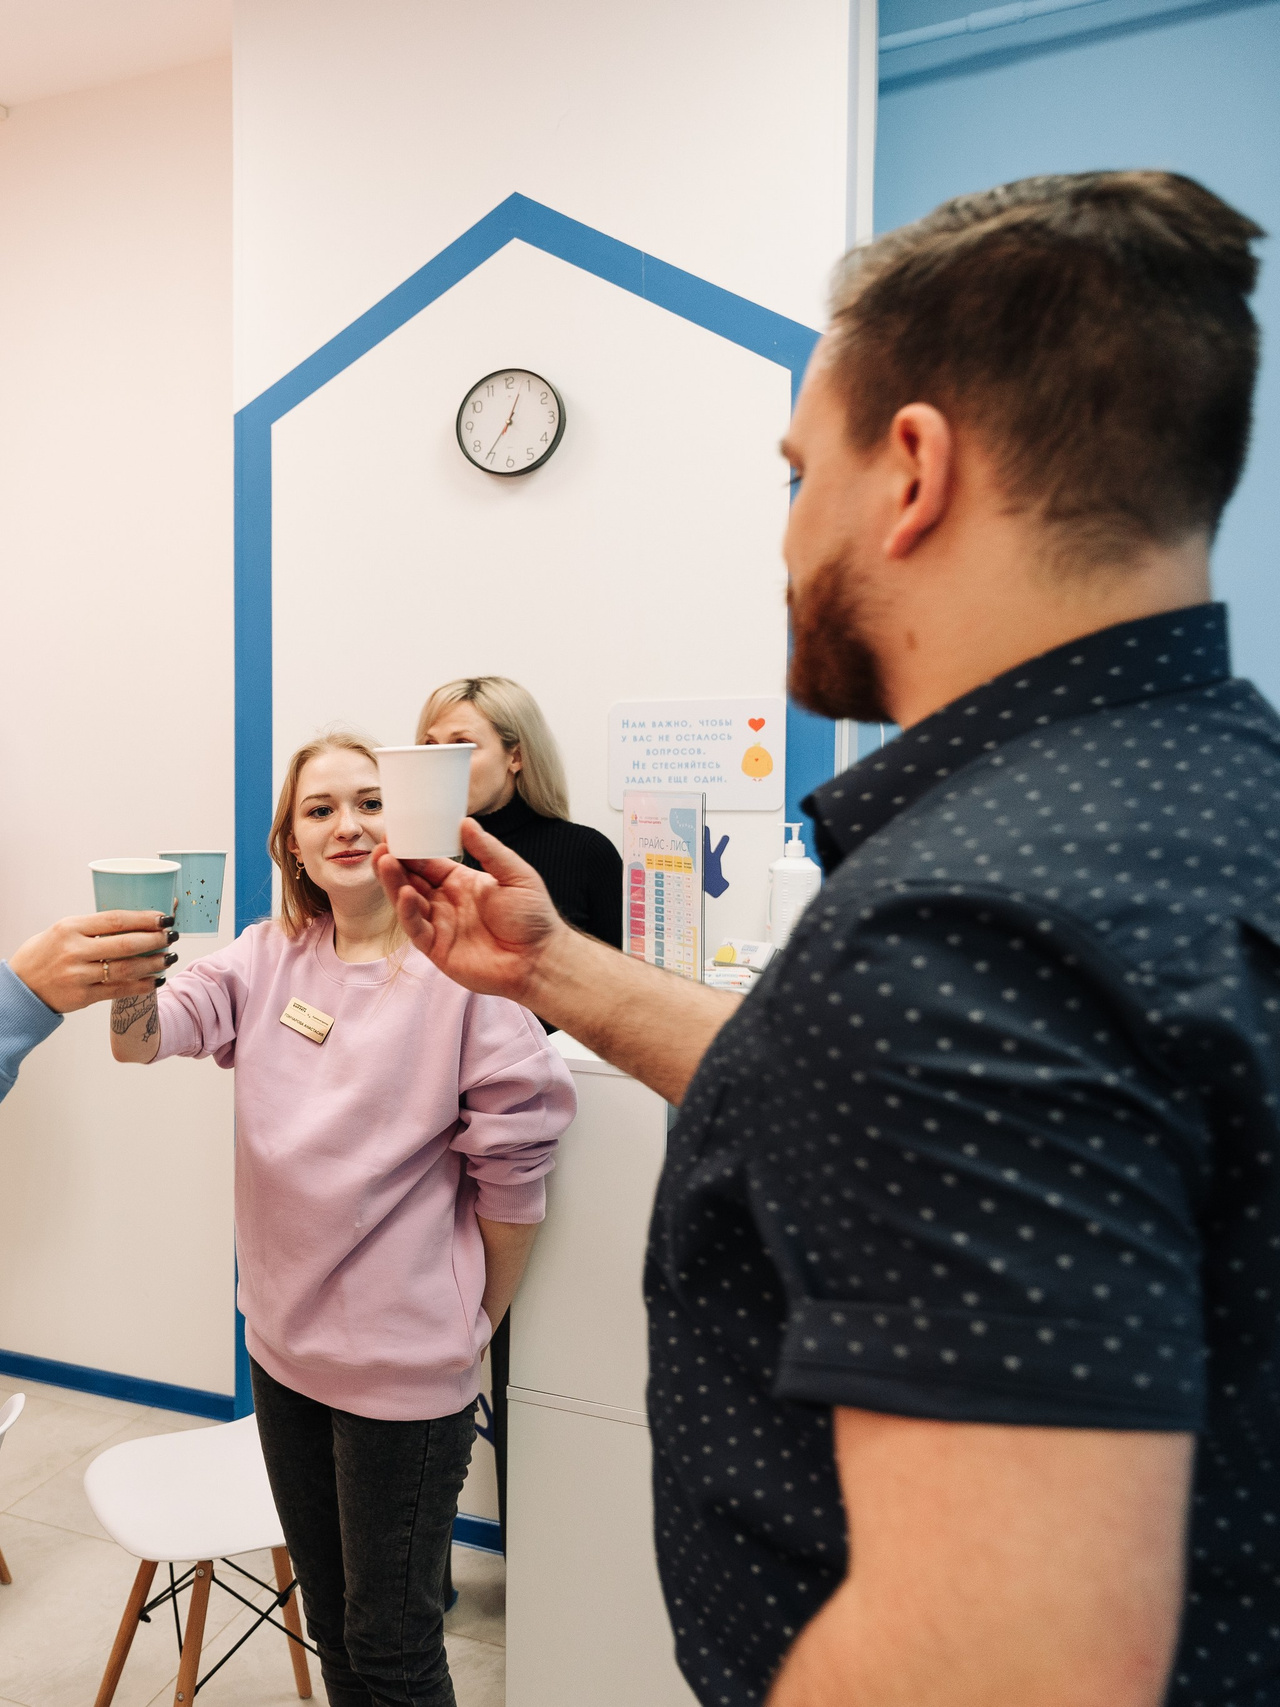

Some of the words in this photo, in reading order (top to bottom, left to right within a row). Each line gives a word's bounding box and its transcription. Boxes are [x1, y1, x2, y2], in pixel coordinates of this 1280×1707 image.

[505, 376, 515, 390] 12
[486, 385, 495, 398] 11
[540, 391, 549, 405] 2
[471, 400, 483, 414] 10
[547, 411, 556, 424] 3
[465, 421, 474, 434] 9
[540, 431, 549, 445] 4
[473, 440, 482, 453] 8
[488, 451, 496, 465] 7
[526, 447, 535, 461] 5
[506, 455, 515, 468] 6
[638, 836, 665, 850] ПРАЙС
[670, 840, 691, 852] ЛИСТ
